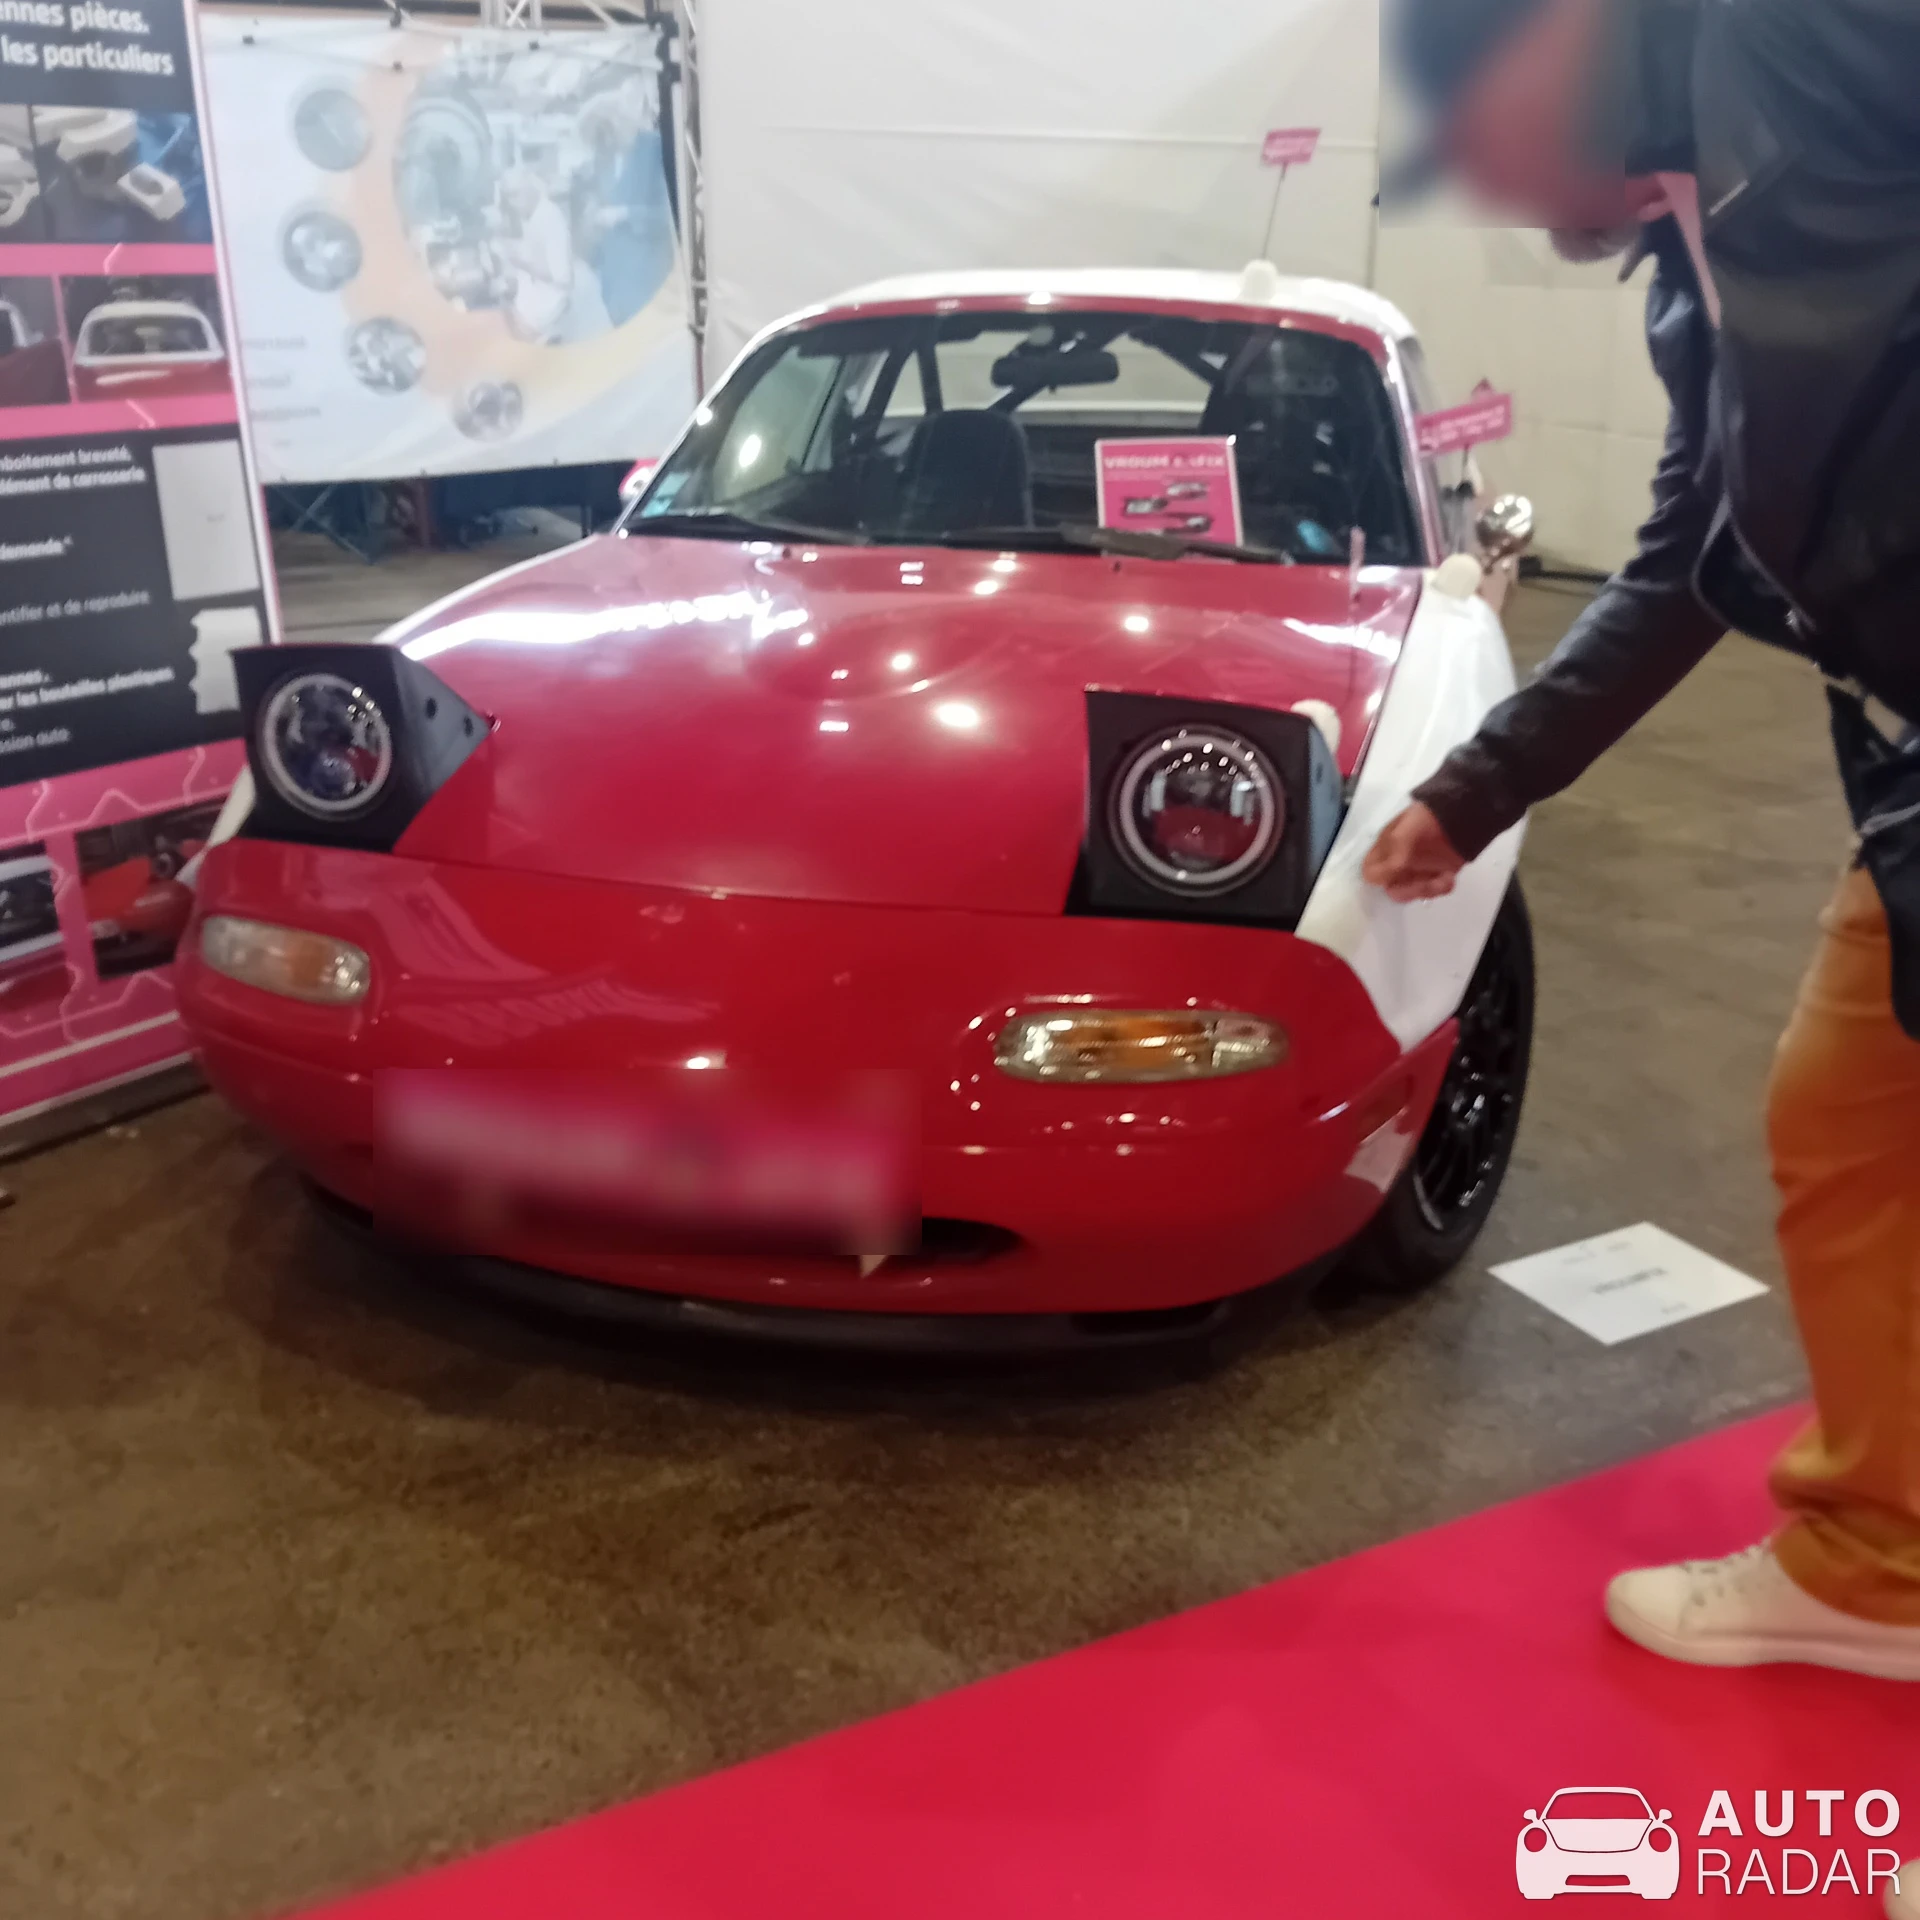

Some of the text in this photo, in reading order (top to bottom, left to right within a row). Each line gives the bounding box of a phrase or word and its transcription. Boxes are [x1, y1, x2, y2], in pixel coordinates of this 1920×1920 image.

[0, 0, 65, 27] nnes
[1, 34, 175, 76] les particuliers
[53, 472, 71, 491] de
